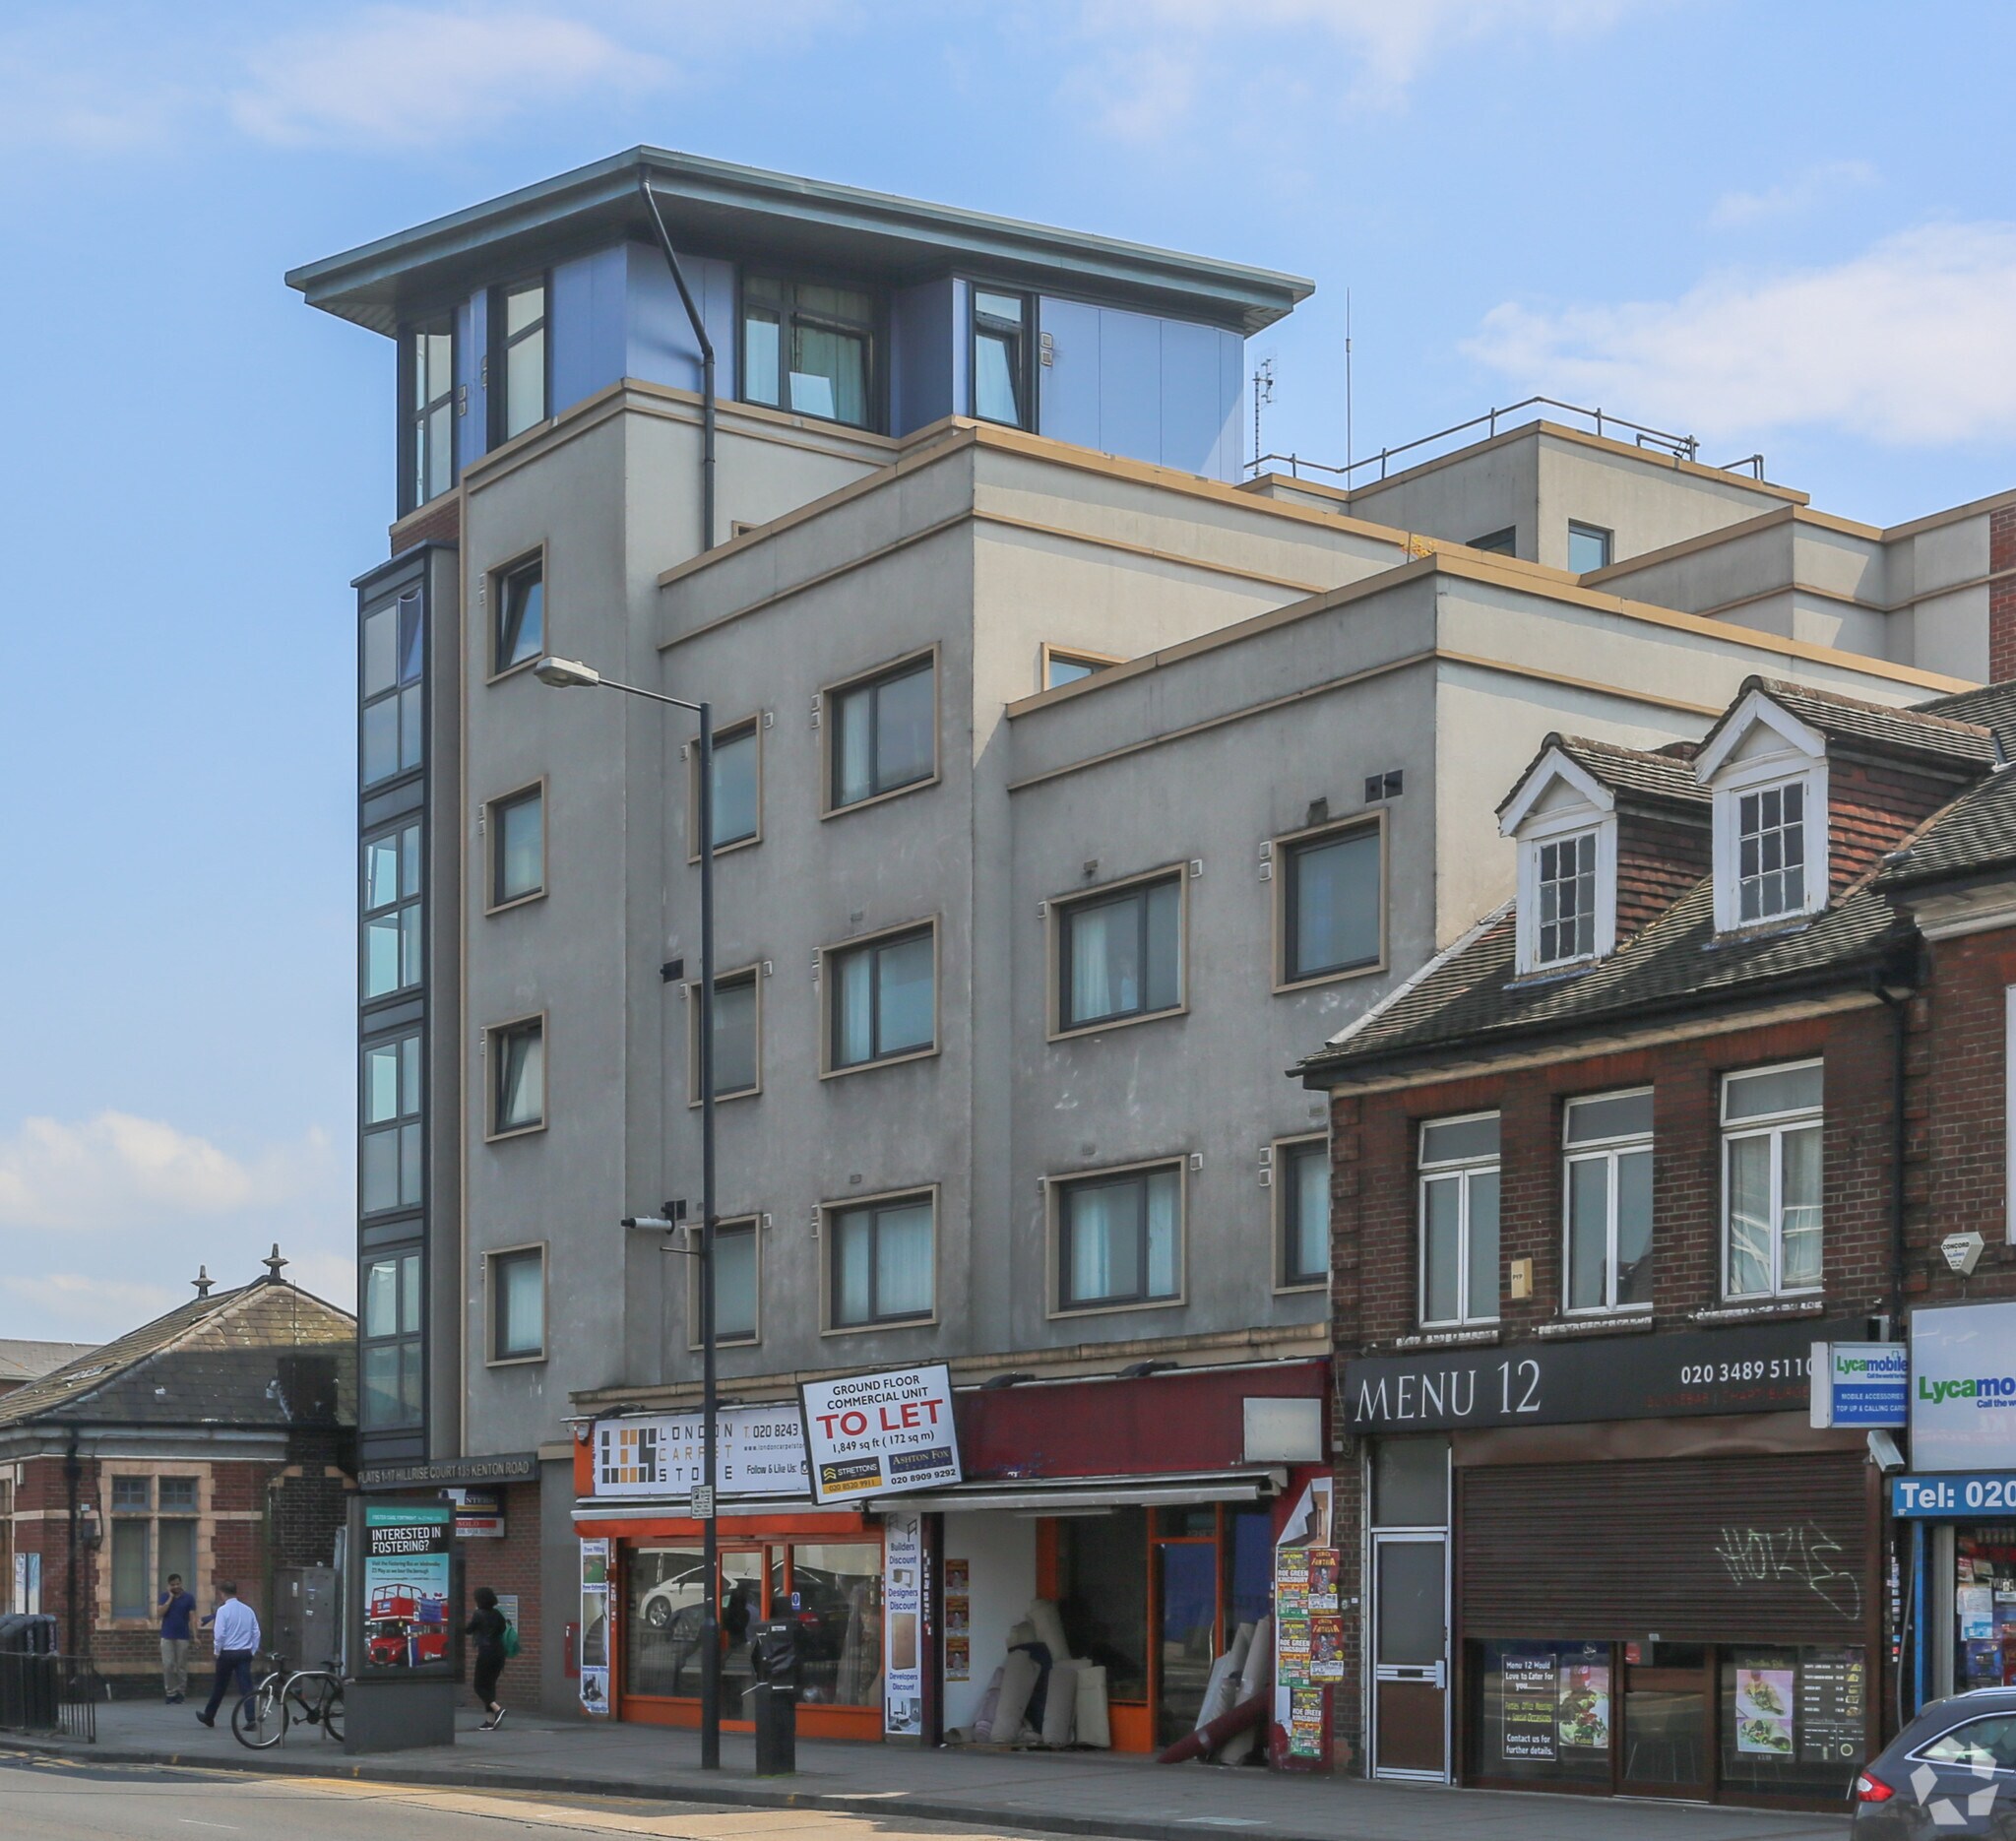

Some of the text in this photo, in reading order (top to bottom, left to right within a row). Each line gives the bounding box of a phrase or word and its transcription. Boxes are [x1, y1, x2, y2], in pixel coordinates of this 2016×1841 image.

[1942, 1241, 1970, 1250] CONCORD
[1836, 1355, 1909, 1374] Lycamobile
[1680, 1365, 1714, 1384] 020
[1719, 1361, 1765, 1382] 3489
[833, 1374, 920, 1396] GROUND FLOOR
[1354, 1359, 1542, 1422] MENU 12
[1919, 1376, 2016, 1405] Lycamo
[827, 1386, 928, 1410] COMMERCIAL UNIT
[1977, 1399, 1992, 1409] Call
[1993, 1399, 2007, 1408] the
[816, 1398, 943, 1439] TO LET
[753, 1425, 772, 1438] 020
[774, 1423, 798, 1437] 8243
[833, 1440, 856, 1454] 1,849
[859, 1441, 871, 1451] sq
[872, 1438, 880, 1448] ft
[889, 1434, 906, 1445] 172
[908, 1435, 919, 1444] sq
[920, 1429, 935, 1441] m)
[893, 1450, 929, 1466] ASHTON
[357, 1470, 381, 1485] FLATS
[429, 1465, 457, 1479] COURT
[471, 1462, 505, 1477] KENTON
[505, 1461, 530, 1475] ROAD
[659, 1466, 732, 1482] STOE
[746, 1465, 767, 1475] Follow
[774, 1464, 786, 1474] Like
[838, 1463, 877, 1477] STRETTONS
[891, 1468, 957, 1486] 020 8909 9292
[1900, 1480, 2016, 1509] Tel: 020
[372, 1527, 430, 1542] INTERESTED
[431, 1526, 441, 1538] IN
[372, 1540, 430, 1554] FOSTERING?
[891, 1543, 915, 1552] Builders
[889, 1555, 917, 1564] Discount
[888, 1588, 918, 1599] Designers
[890, 1601, 917, 1611] Discount
[1506, 1661, 1551, 1670] Menu 12 Would
[889, 1672, 918, 1681] Developers
[1505, 1672, 1554, 1681] Love to Cater for
[1506, 1734, 1531, 1743] Contact
[1541, 1734, 1550, 1743] for
[1506, 1746, 1553, 1755] further details.
